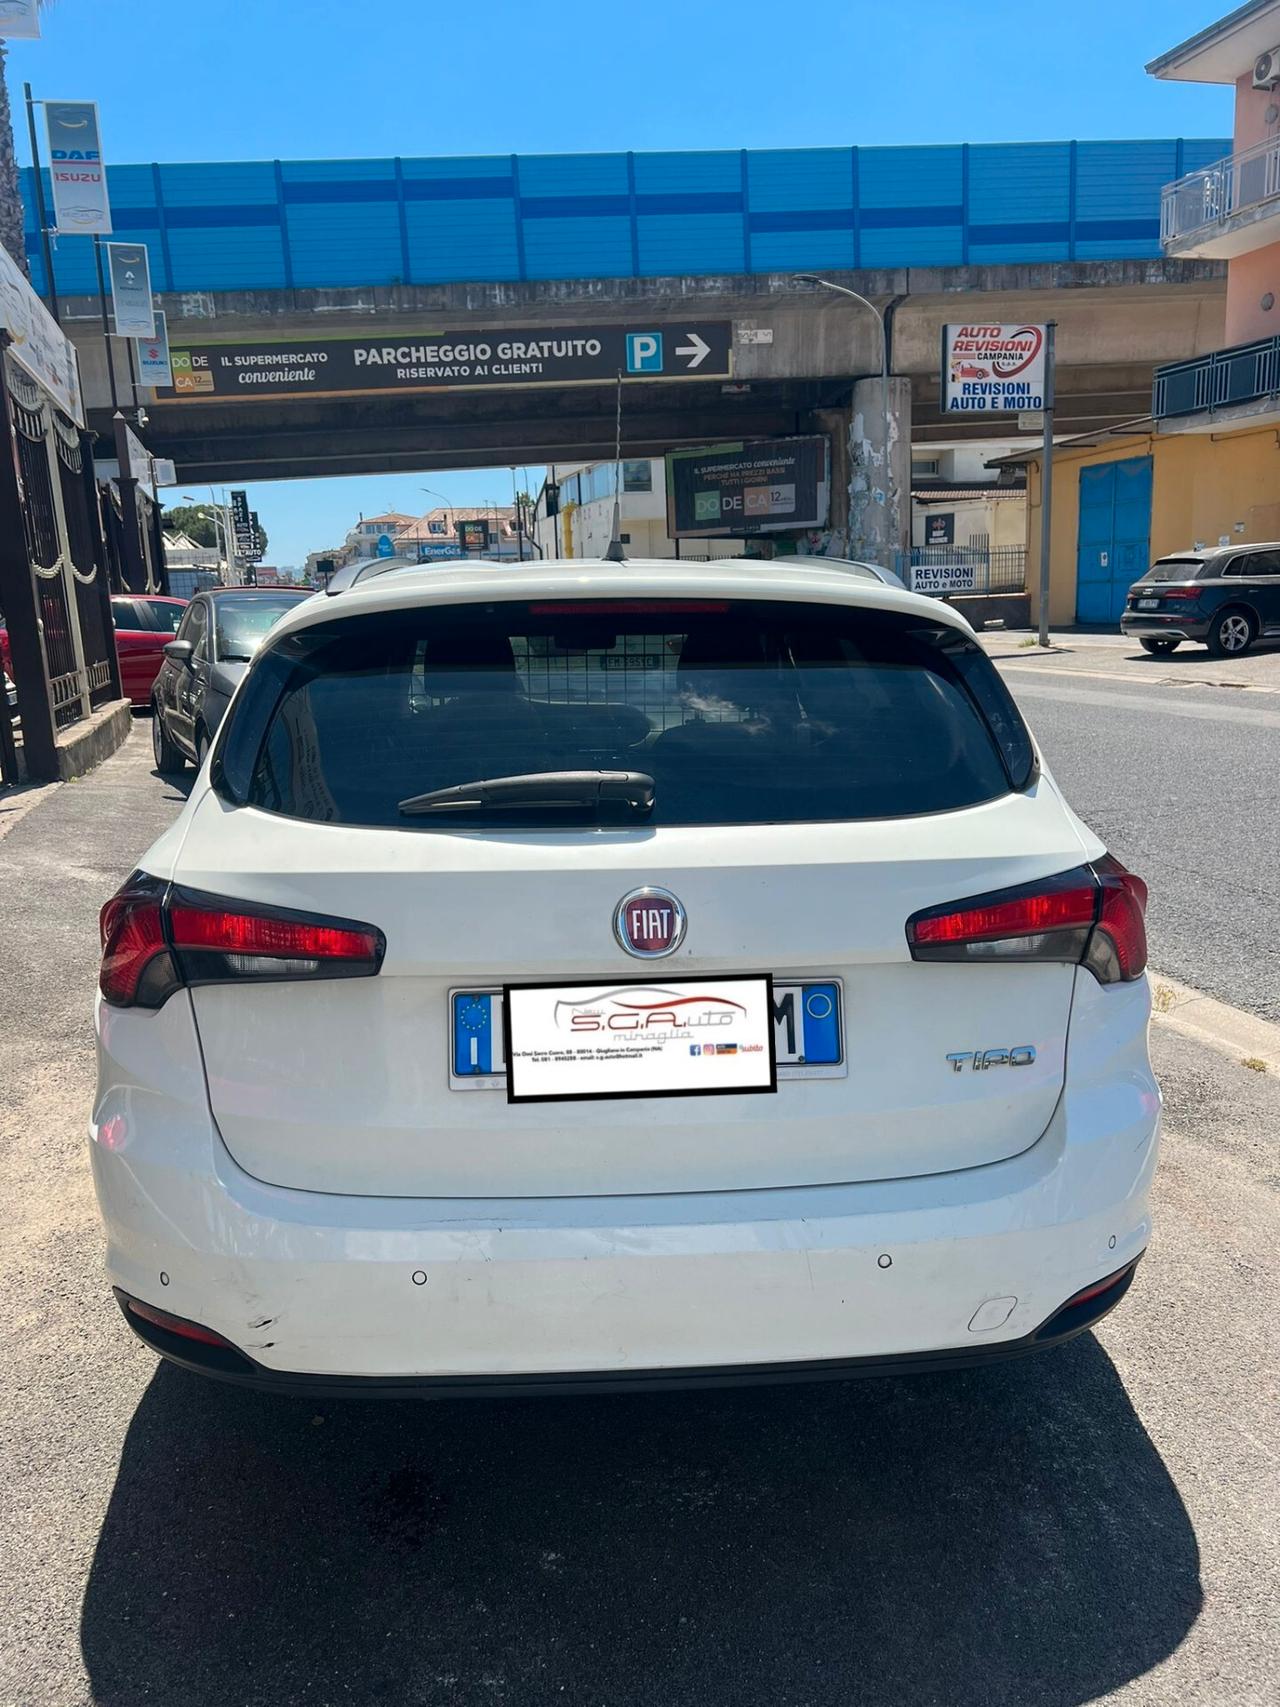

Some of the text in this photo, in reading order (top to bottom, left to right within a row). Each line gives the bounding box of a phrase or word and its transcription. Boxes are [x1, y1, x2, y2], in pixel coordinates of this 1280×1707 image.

[51, 150, 100, 160] DAF
[55, 172, 101, 182] ISUZU
[957, 326, 1001, 338] AUTO
[353, 338, 602, 366] PARCHEGGIO GRATUITO
[633, 336, 657, 369] P
[953, 340, 1033, 352] REVISIONI
[171, 356, 209, 368] DO DE
[220, 352, 329, 367] IL SUPERMERCATO
[977, 352, 1024, 361] CAMPANIA
[238, 367, 317, 384] conveniente
[397, 362, 544, 379] RISERVATO AI CLIENTI
[176, 377, 193, 388] CA
[962, 382, 1031, 396] REVISIONI
[950, 395, 1042, 410] AUTO E MOTO
[696, 499, 719, 513] DO
[722, 496, 742, 511] DE
[745, 494, 767, 508] CA
[770, 491, 781, 502] 12
[915, 567, 974, 580] REVISIONI
[915, 580, 940, 590] AUTO
[950, 579, 973, 589] MOTO
[632, 909, 670, 940] FIAT
[946, 1045, 1037, 1072] TIPO
